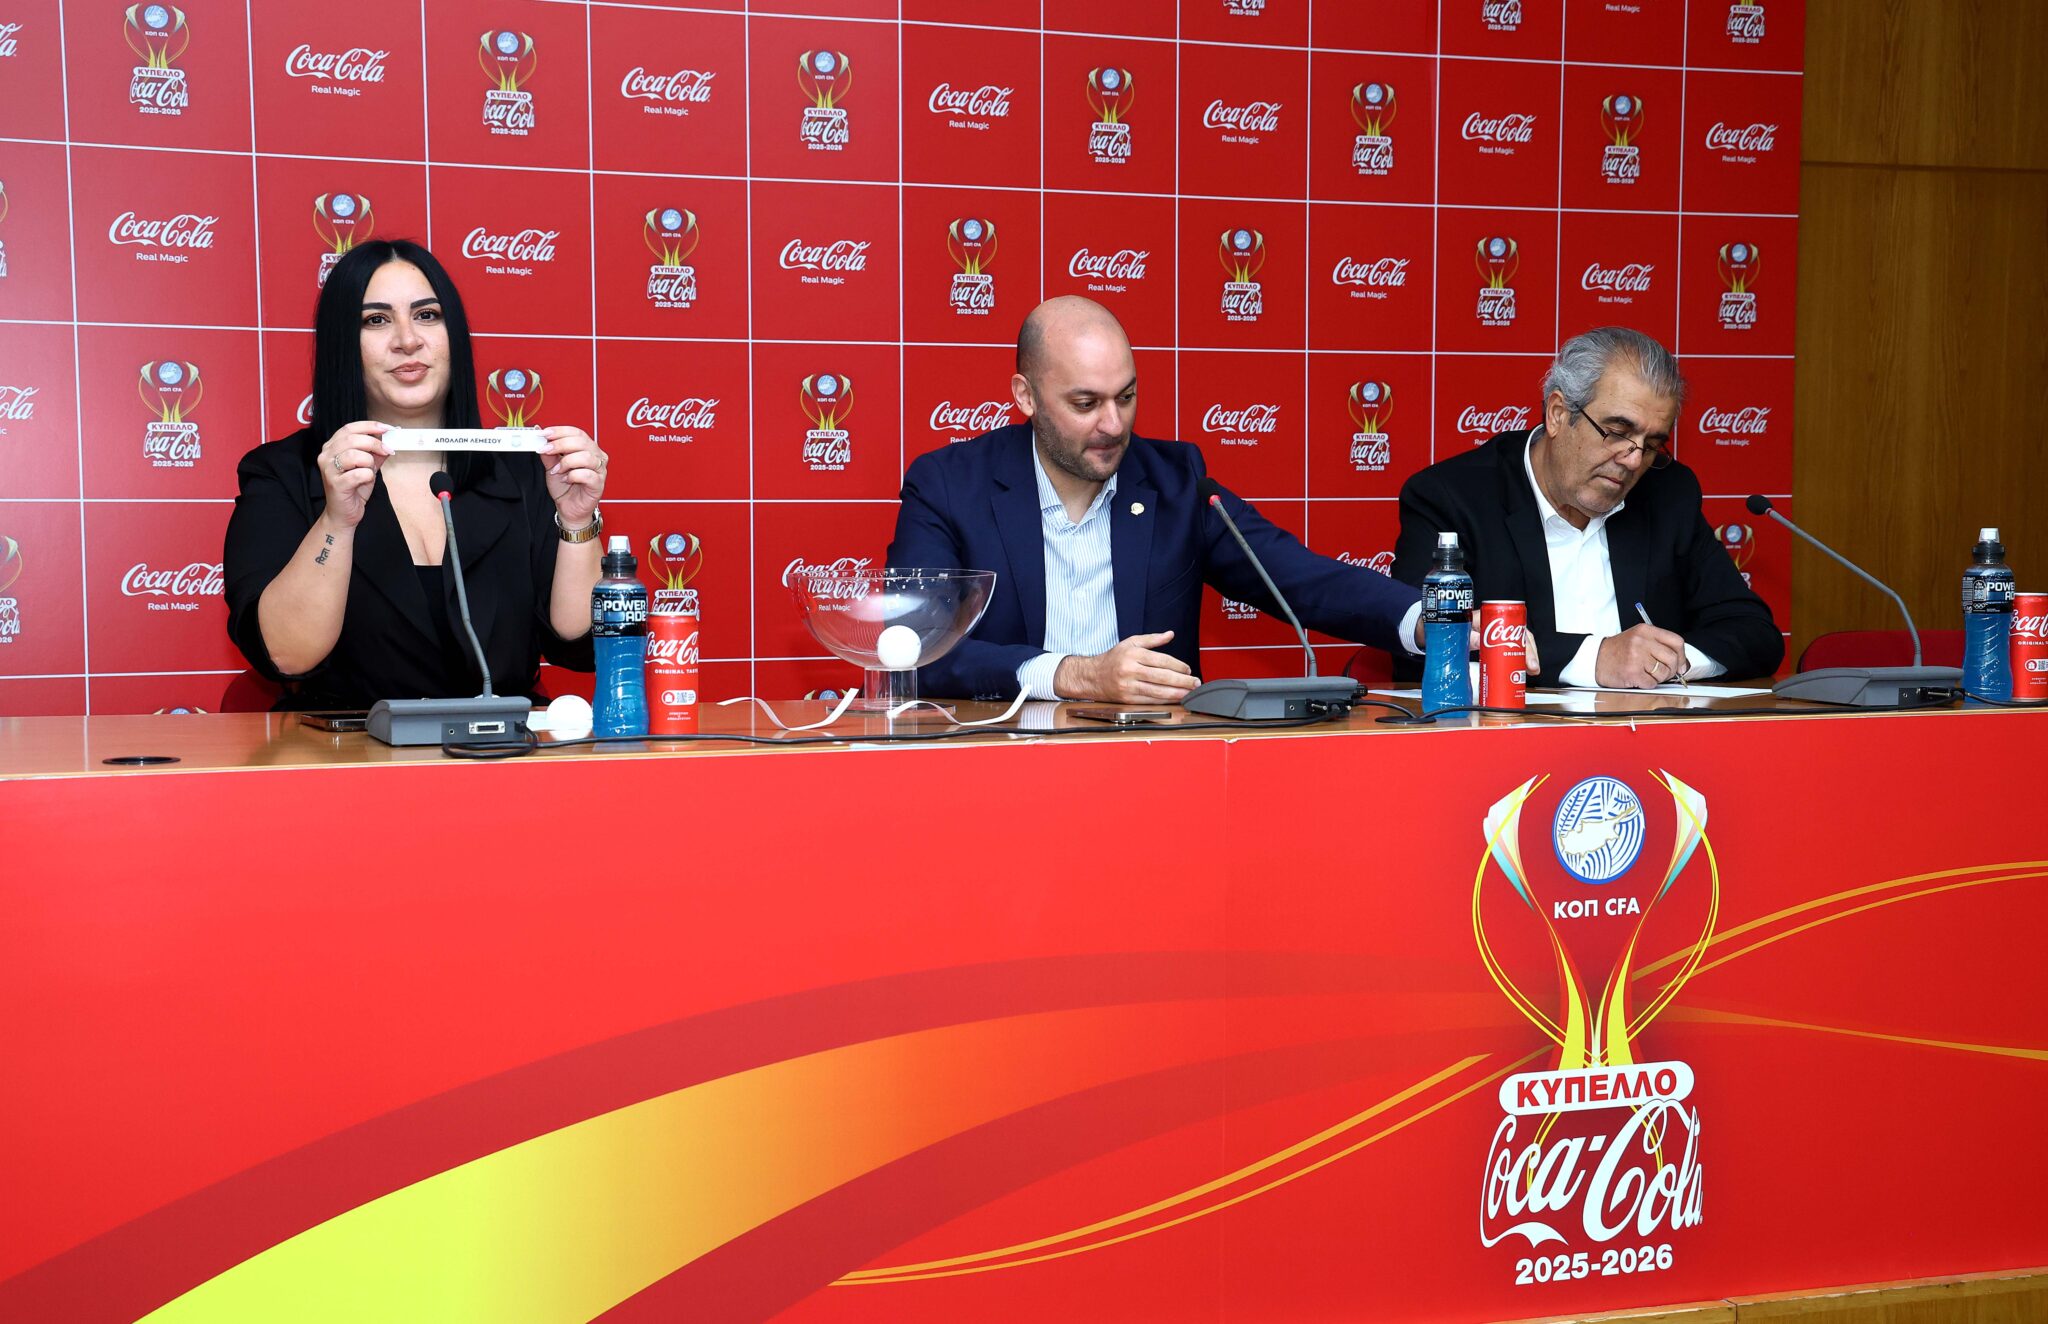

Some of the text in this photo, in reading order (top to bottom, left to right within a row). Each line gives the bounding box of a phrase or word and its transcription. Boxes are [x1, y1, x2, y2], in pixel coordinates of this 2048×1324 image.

[286, 44, 390, 82] Coca-Cola
[312, 86, 360, 96] Real Magic
[621, 67, 716, 102] Coca-Cola
[644, 106, 688, 116] Real Magic
[929, 83, 1014, 116] Coca-Cola
[949, 120, 989, 130] Real Magic
[1204, 100, 1283, 131] Coca-Cola
[1462, 112, 1537, 142] Coca-Cola
[1238, 136, 1258, 144] Magic
[1706, 122, 1778, 151] Coca-Cola
[109, 212, 219, 248] Coca-Cola
[160, 254, 188, 263] Magic
[462, 228, 561, 261] Coca-Cola
[780, 239, 871, 270] Coca-Cola
[486, 266, 532, 276] Real Magic
[1069, 248, 1150, 279] Coca-Cola
[1333, 257, 1411, 286] Coca-Cola
[1582, 263, 1655, 291] Coca-Cola
[821, 277, 844, 285] Magic
[1105, 285, 1126, 293] Magic
[626, 397, 720, 429] Coca-Cola
[930, 401, 1015, 430] Coca-Cola
[1203, 404, 1281, 432] Coca-Cola
[1457, 405, 1531, 433] Coca-Cola
[1699, 407, 1771, 434] Coca-Cola
[669, 435, 692, 443] Magic
[121, 563, 225, 596] Coca-Cola
[1987, 582, 2015, 591] POWE
[148, 602, 198, 611] Real Magic
[604, 600, 645, 611] POWER
[2005, 591, 2014, 600] AD
[626, 611, 646, 621] ADE
[1553, 896, 1641, 919] ΚΟΠ CFA
[1517, 1068, 1677, 1108] ΚΥΠΕΛΛΟ
[1480, 1099, 1703, 1248] Coca-Cola
[1514, 1245, 1673, 1285] 2025-2026
